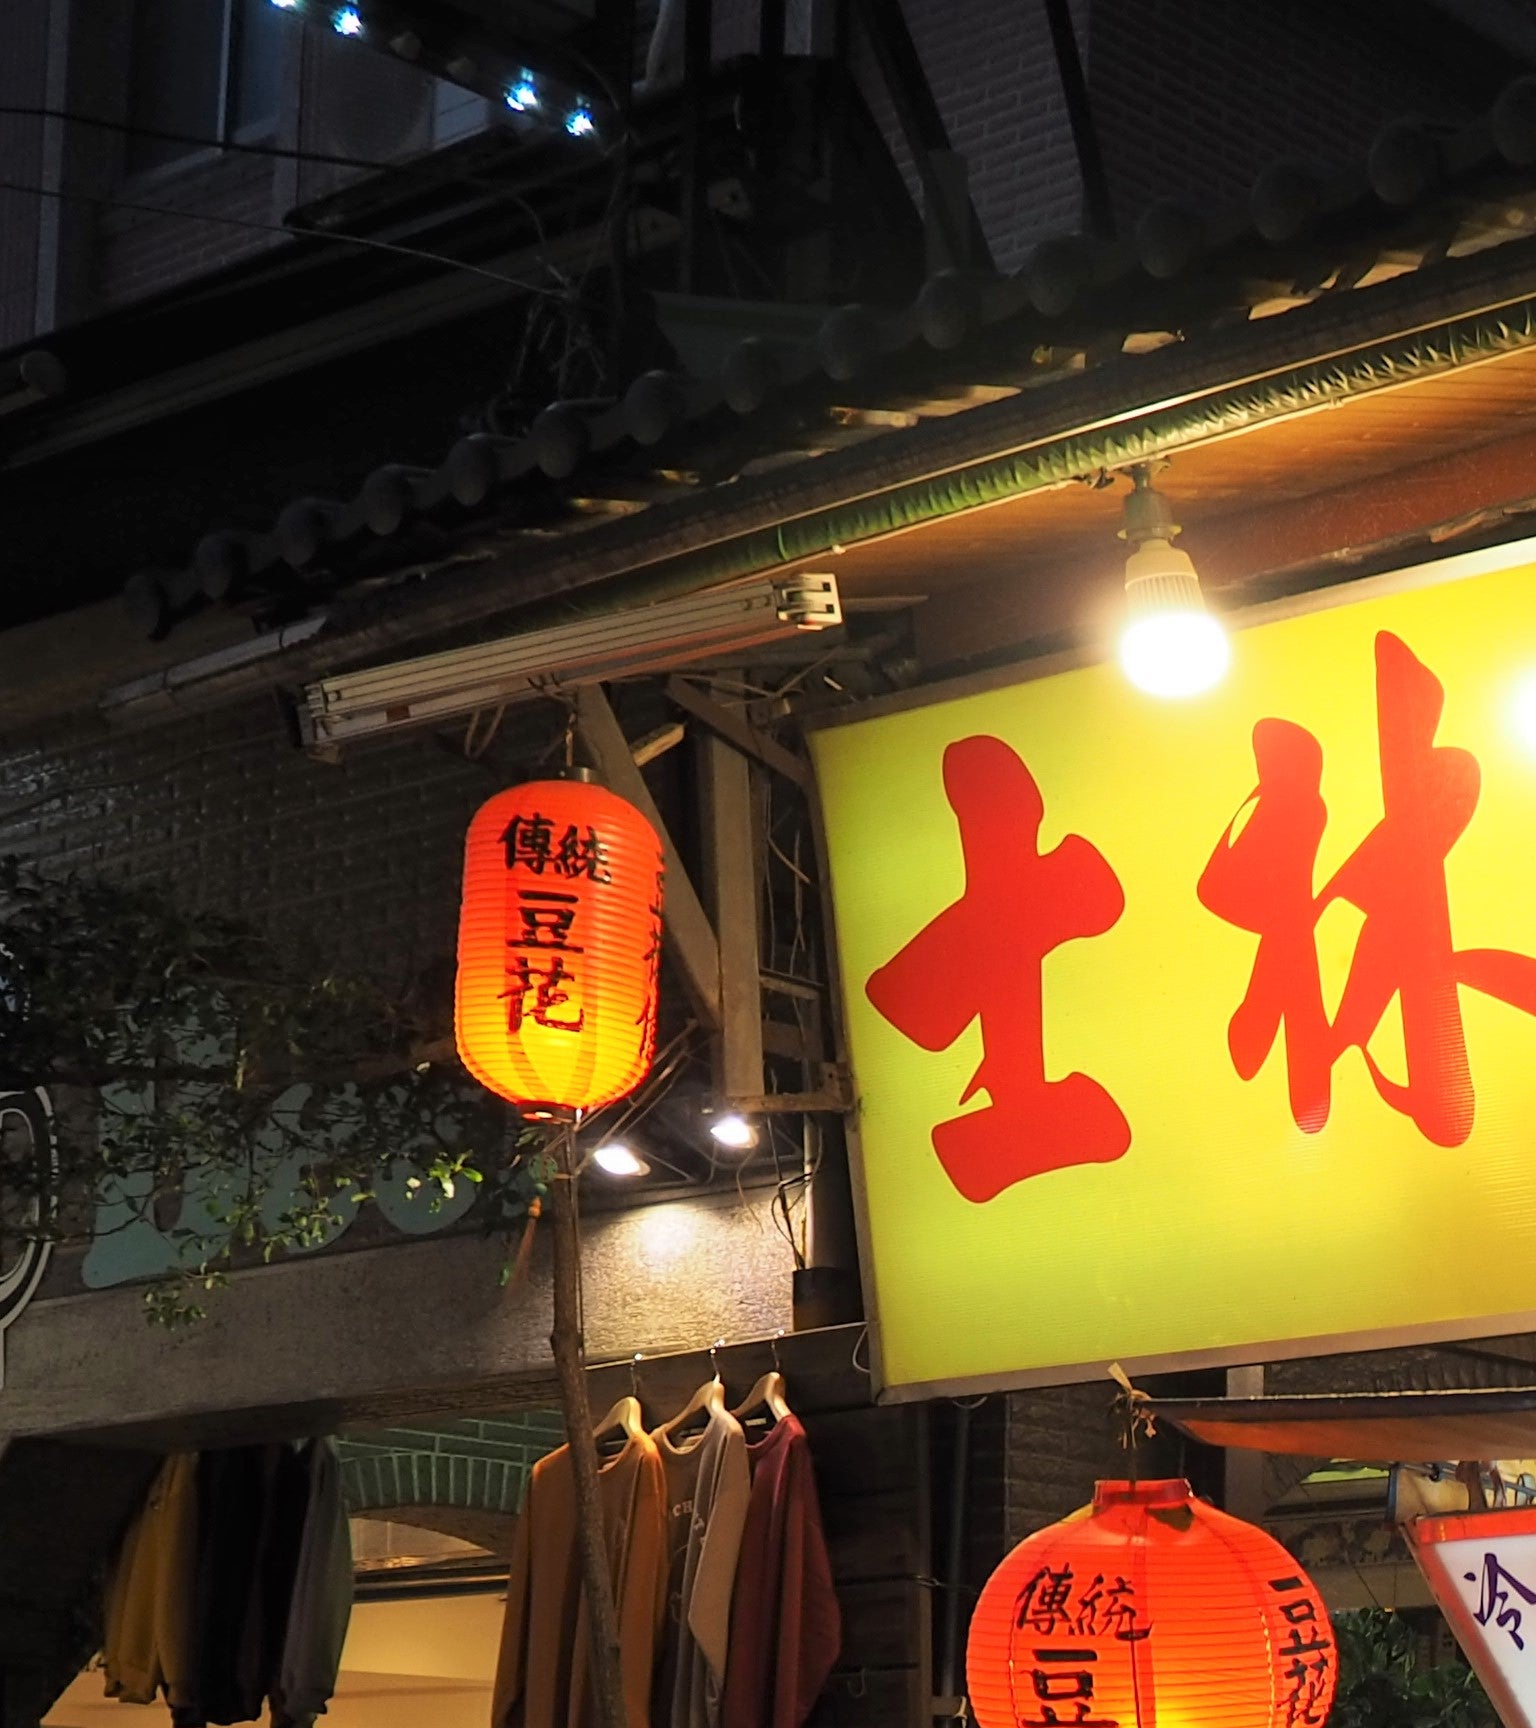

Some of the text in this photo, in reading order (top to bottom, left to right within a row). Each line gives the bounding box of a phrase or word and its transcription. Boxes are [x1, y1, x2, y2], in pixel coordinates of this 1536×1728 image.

[496, 812, 612, 885] 傳統
[496, 889, 585, 1034] 豆花
[1015, 1562, 1155, 1642] 傳統
